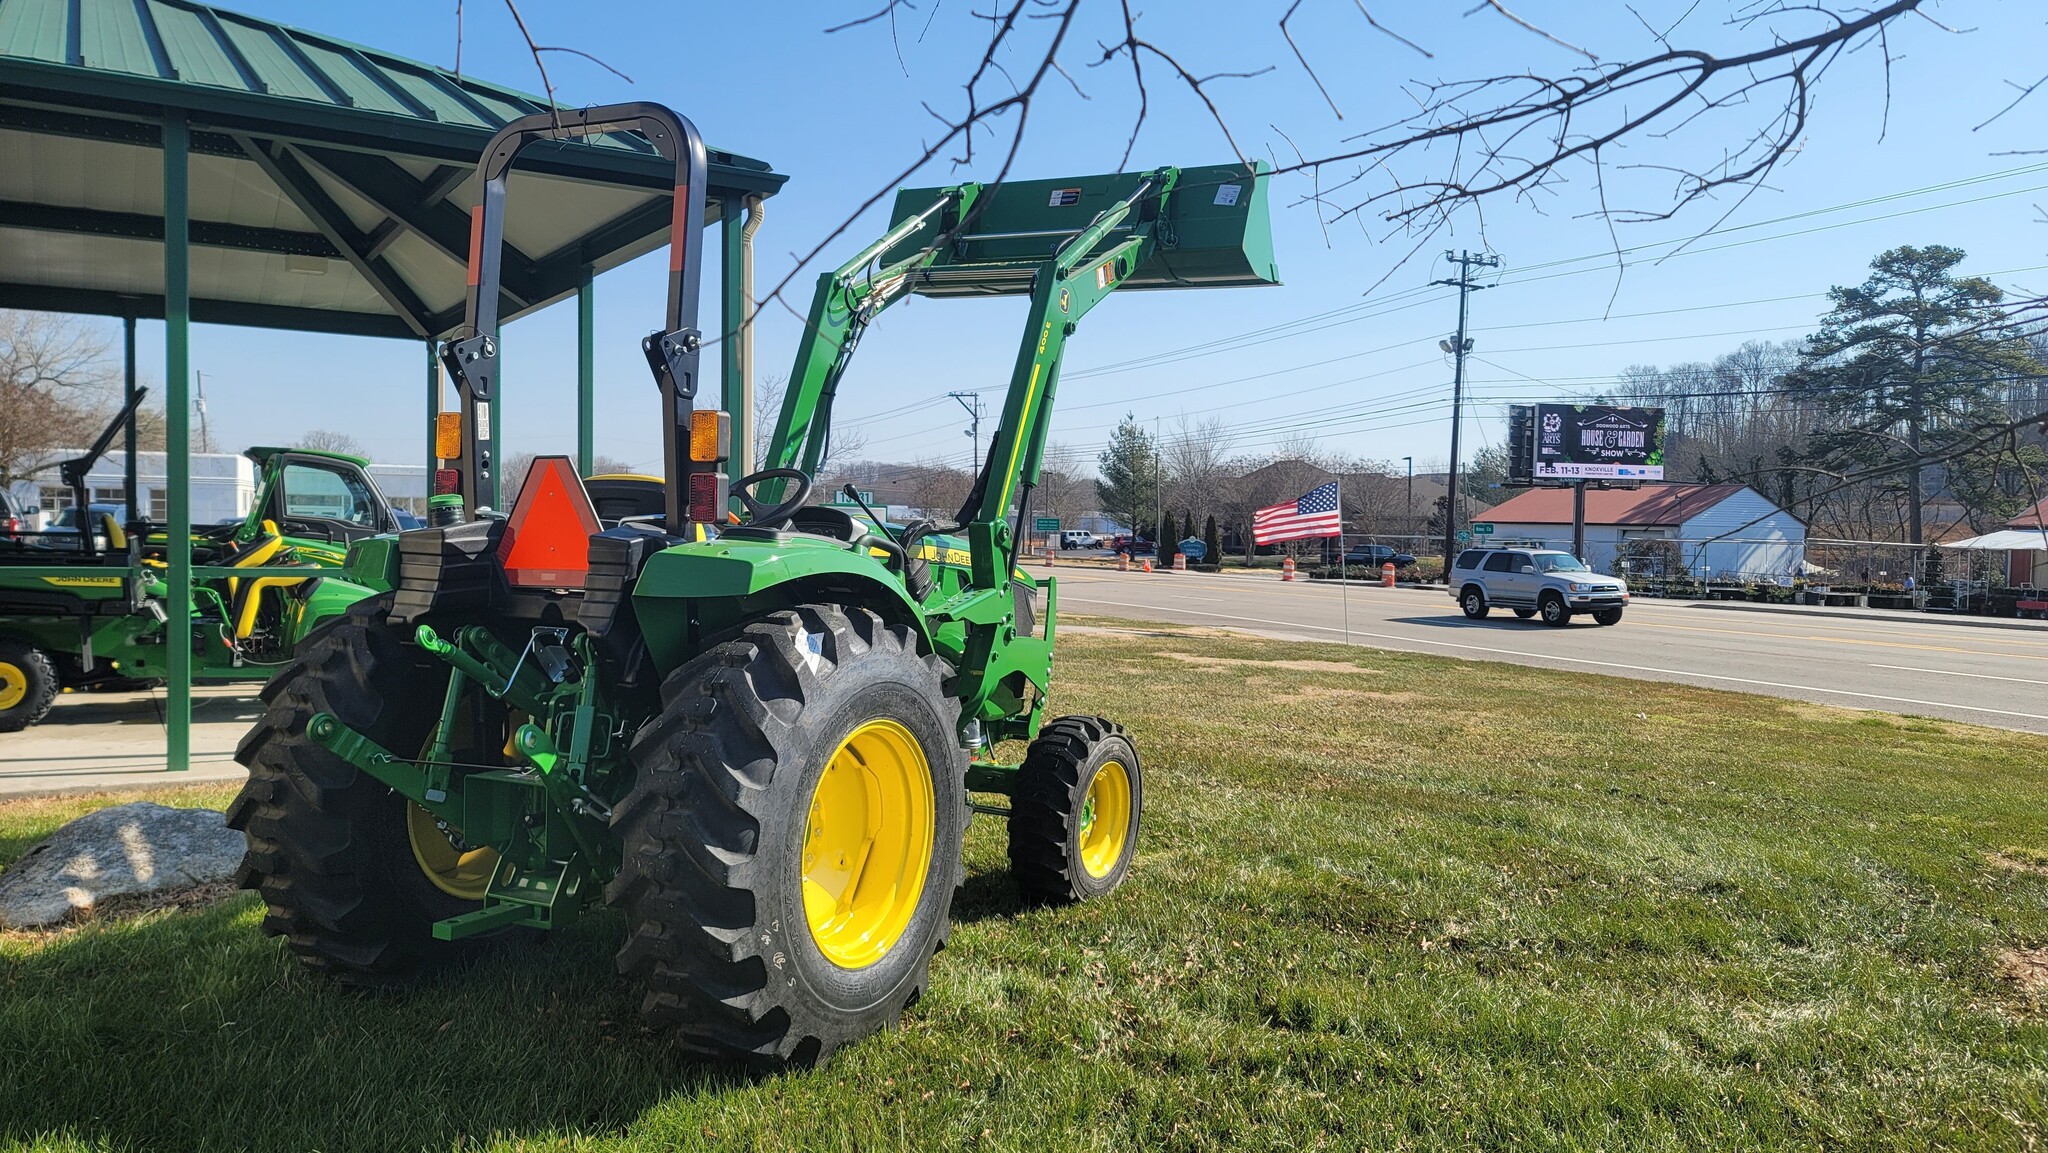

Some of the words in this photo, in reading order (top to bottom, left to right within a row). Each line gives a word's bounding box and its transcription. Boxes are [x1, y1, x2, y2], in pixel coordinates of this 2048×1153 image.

[1040, 329, 1049, 355] 400
[1541, 435, 1561, 444] ARTS
[1581, 429, 1604, 447] HOUSE
[1604, 430, 1619, 448] &
[1617, 431, 1645, 448] GARDEN
[1601, 449, 1624, 457] SHOW
[1539, 466, 1559, 474] FEB.
[1561, 466, 1580, 475] 11-13
[931, 549, 954, 564] JOHN
